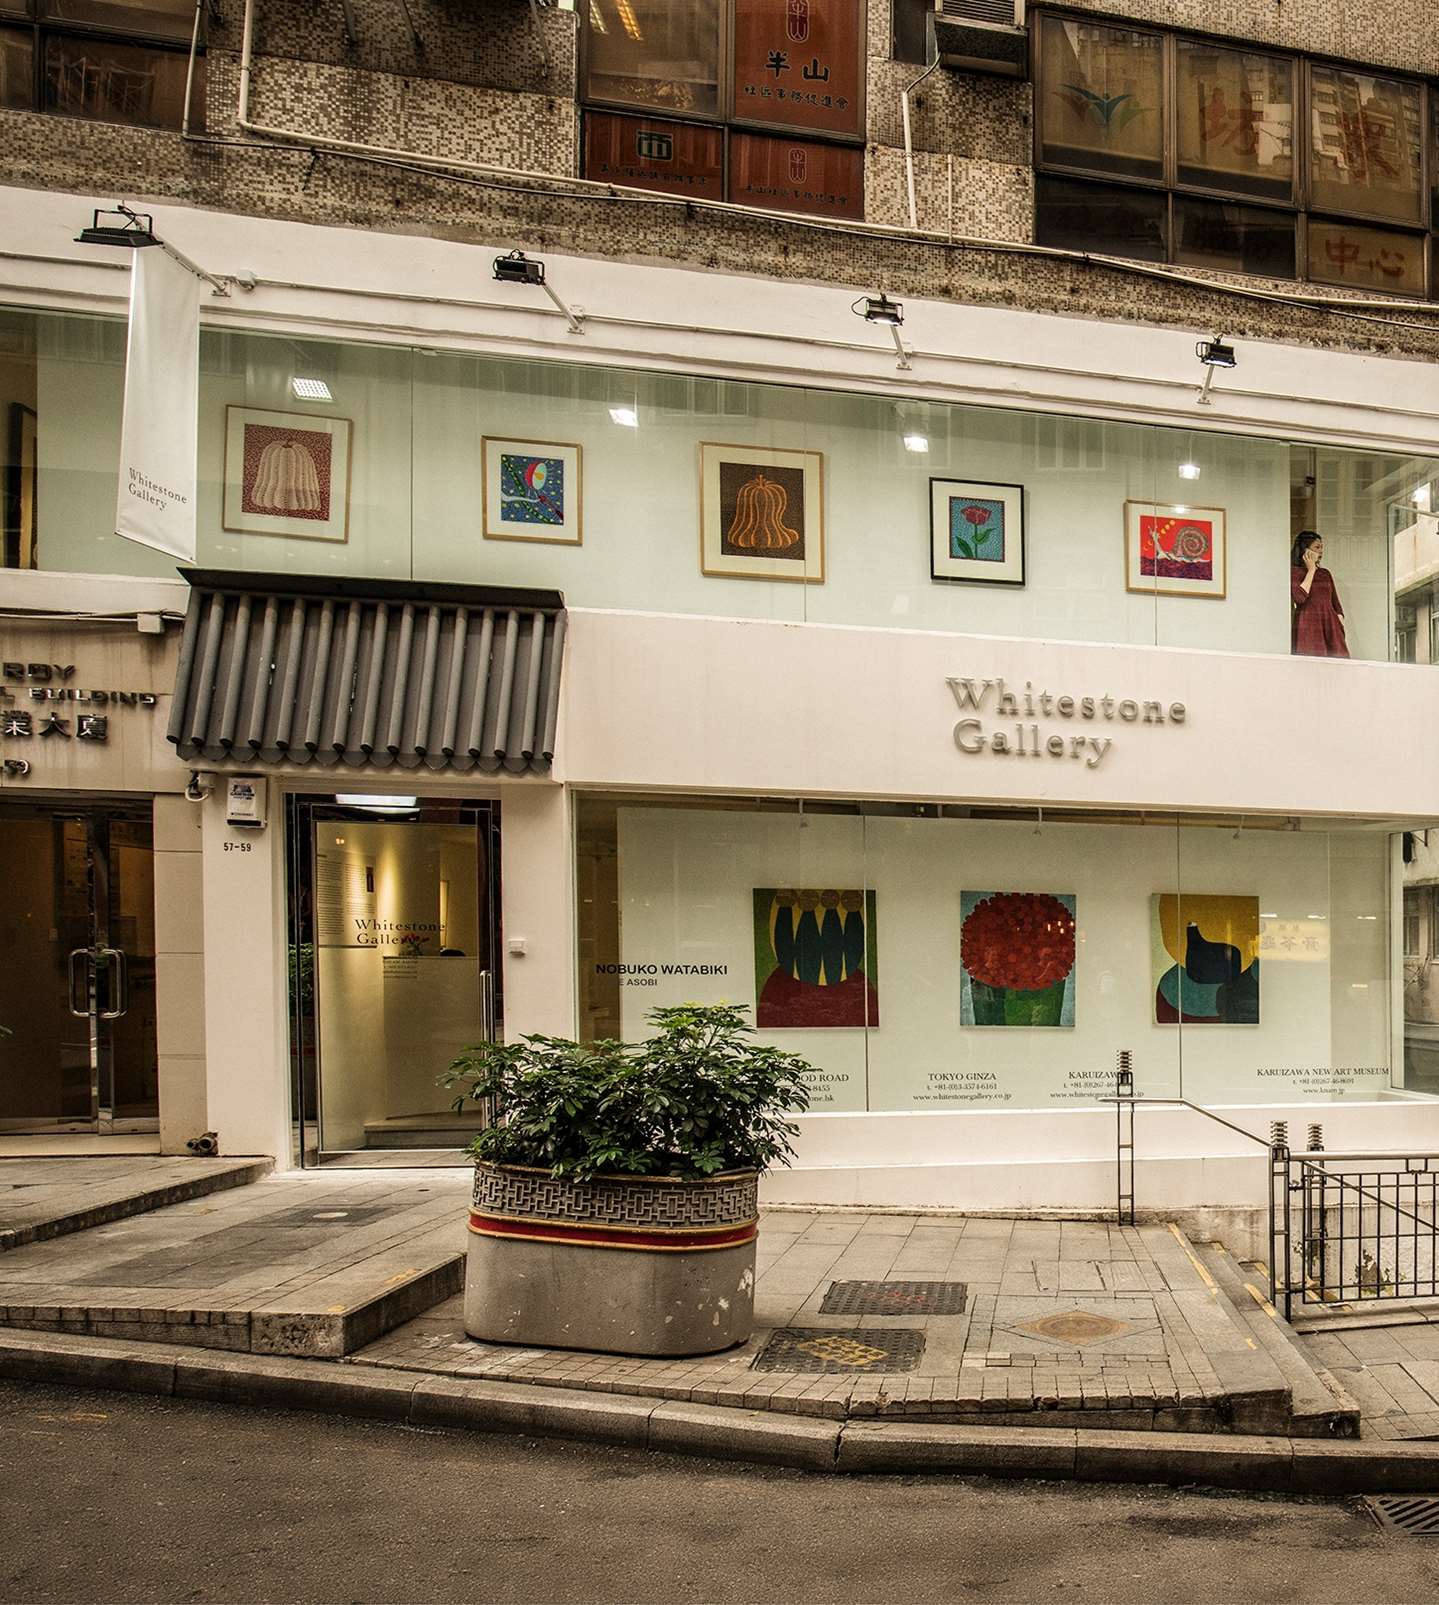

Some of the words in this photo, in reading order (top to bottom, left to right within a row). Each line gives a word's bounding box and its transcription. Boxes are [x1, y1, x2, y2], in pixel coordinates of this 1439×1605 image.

[764, 49, 831, 83] 半山
[1325, 235, 1406, 278] 中心
[129, 467, 188, 504] Whitestone
[128, 482, 167, 512] Gallery
[28, 687, 158, 708] BUILDING
[945, 676, 1187, 724] Whitestone
[953, 718, 1113, 769] Gallery
[223, 842, 252, 853] 57-59
[355, 919, 446, 931] Whitestone
[357, 932, 412, 945] Galle
[596, 964, 657, 975] NOBUKO
[661, 964, 728, 975] WATABIKI
[626, 978, 658, 987] ASOBI
[819, 1073, 849, 1082] ROAD
[928, 1073, 963, 1081] TOKYO
[965, 1073, 997, 1081] GINZA
[1069, 1071, 1120, 1080] KARUIZAW
[1257, 1068, 1310, 1077] KARUIZAWA
[1312, 1068, 1331, 1076] NEW
[1333, 1068, 1351, 1076] ART
[1353, 1067, 1390, 1076] MUSEUM
